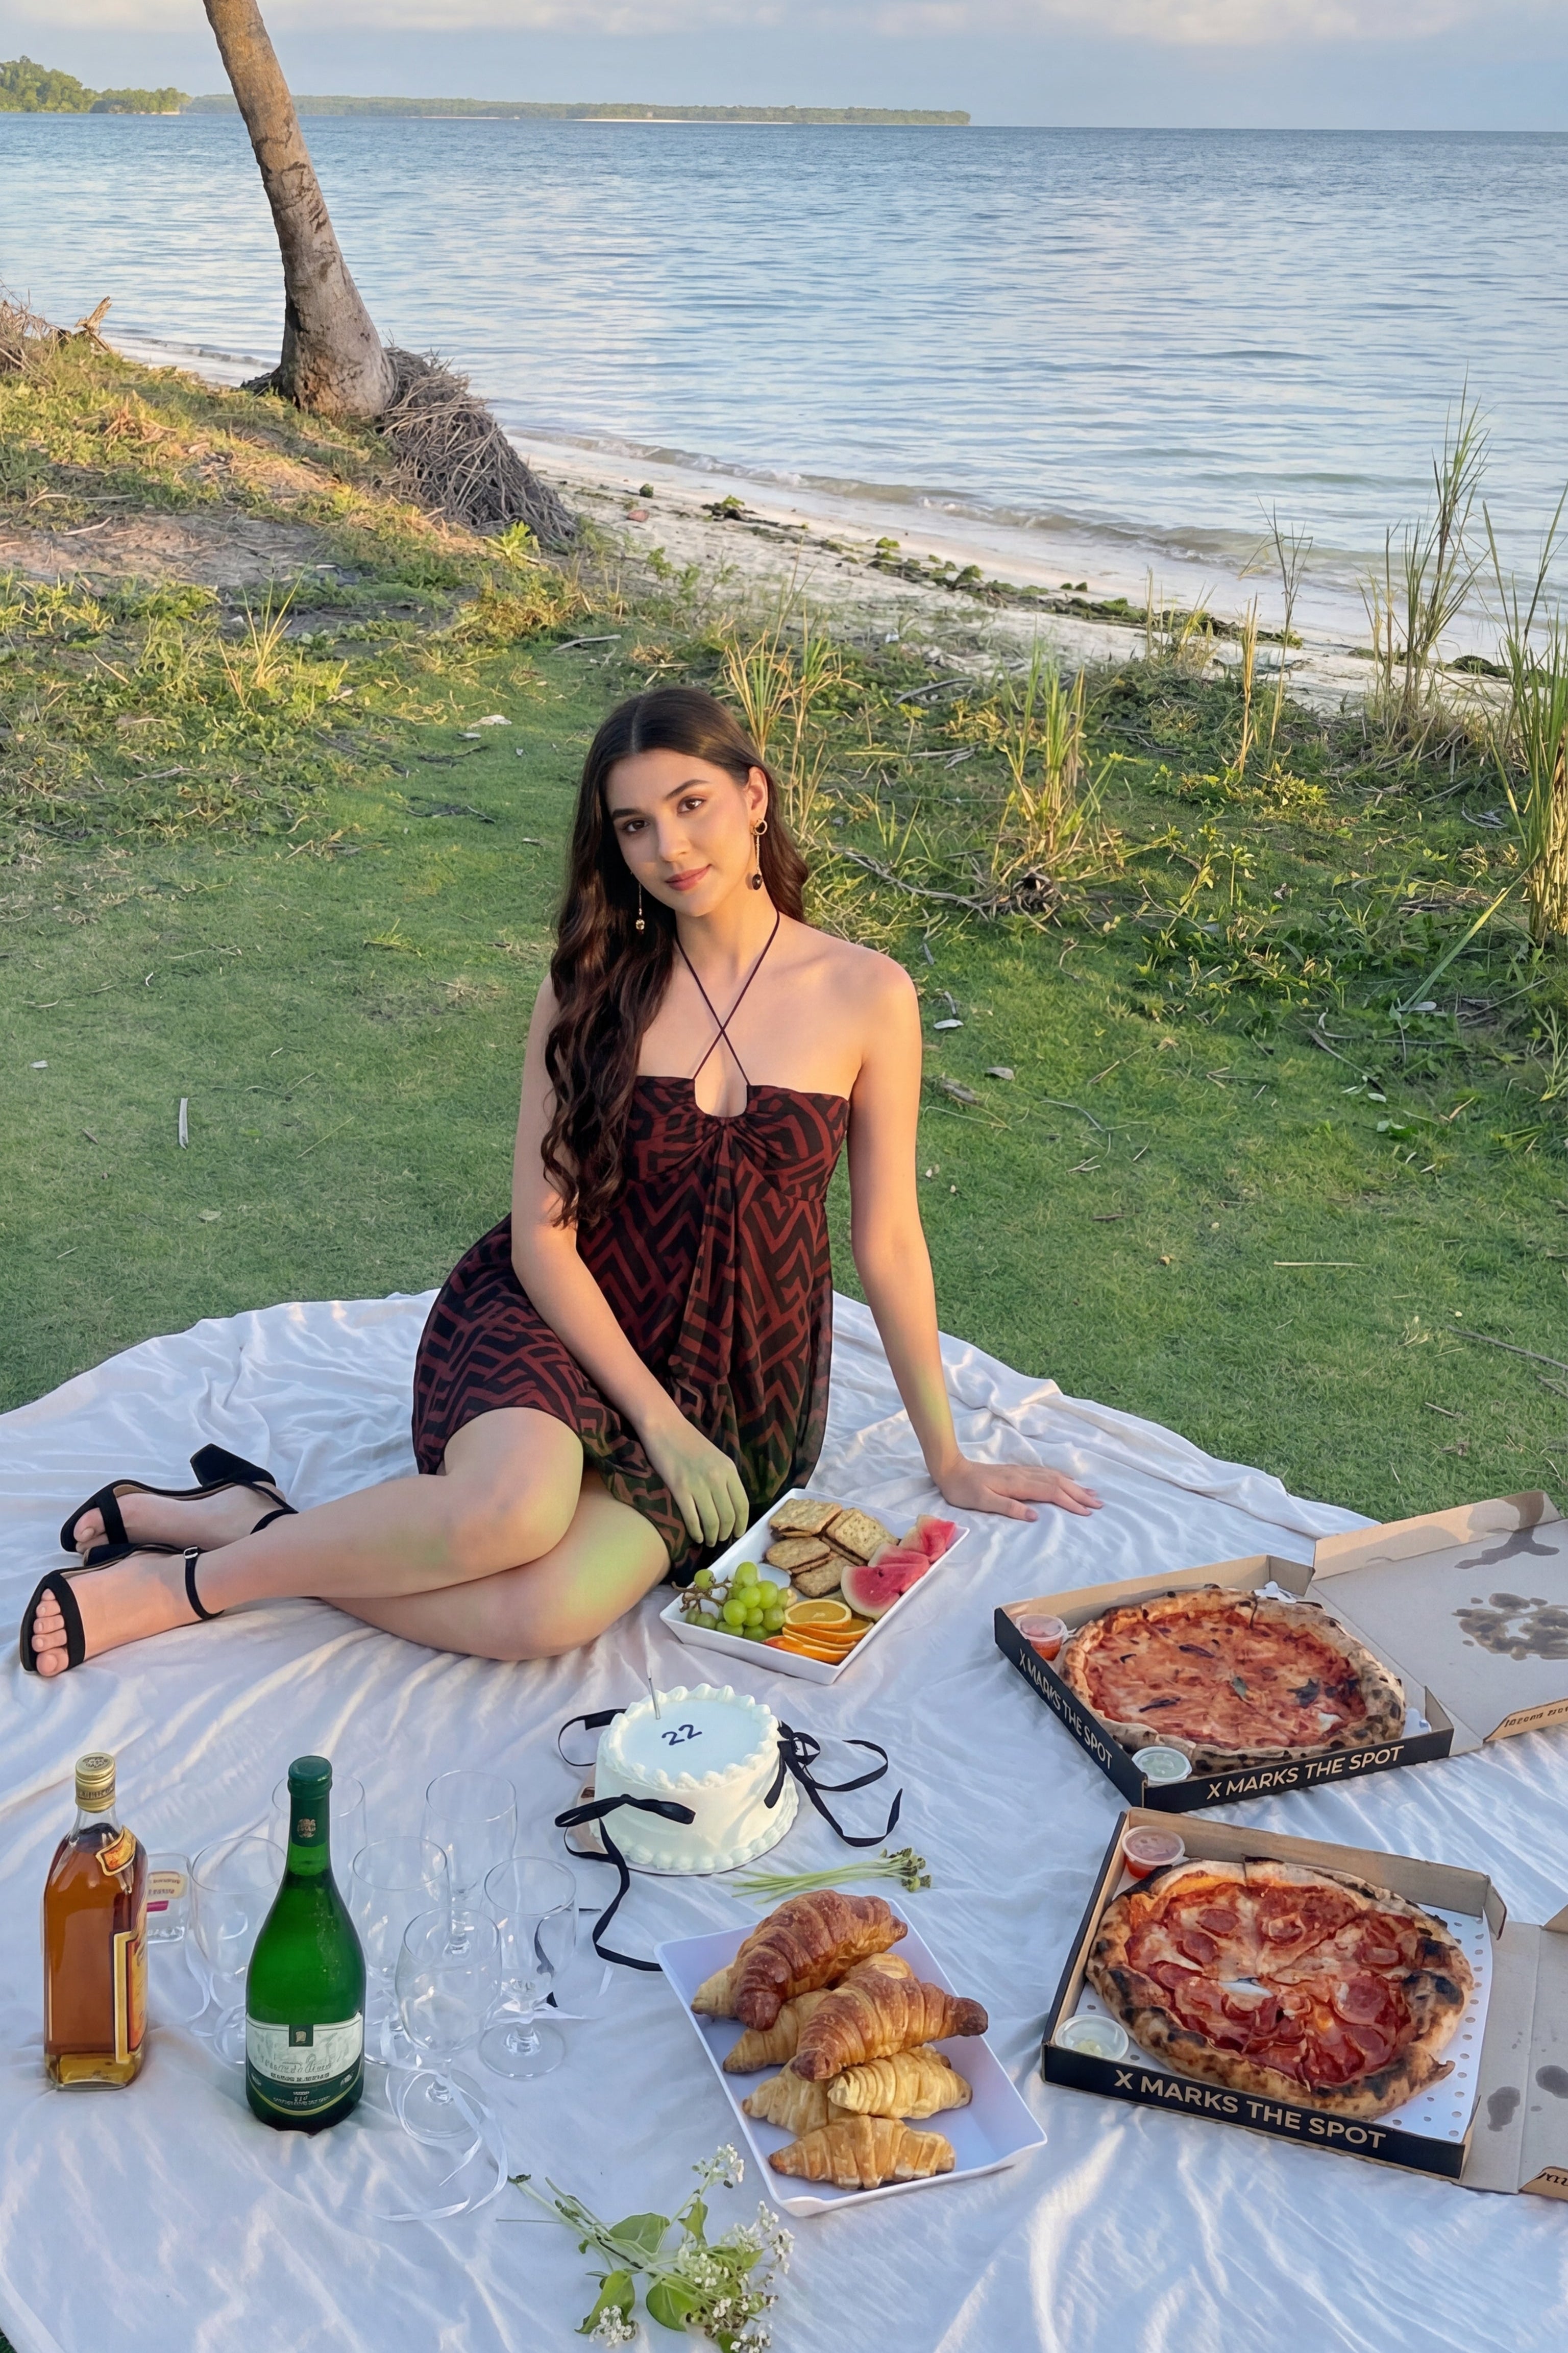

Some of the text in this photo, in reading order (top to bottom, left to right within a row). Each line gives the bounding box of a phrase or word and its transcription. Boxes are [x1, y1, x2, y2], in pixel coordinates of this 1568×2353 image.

[662, 1724, 702, 1745] 22
[1020, 1648, 1026, 1672] X
[1063, 1700, 1083, 1736] THE
[1084, 1726, 1113, 1769] SPOT
[1207, 1745, 1405, 1800] X MARKS THE SPOT
[1114, 2069, 1387, 2148] X MARKS THE SPOT
